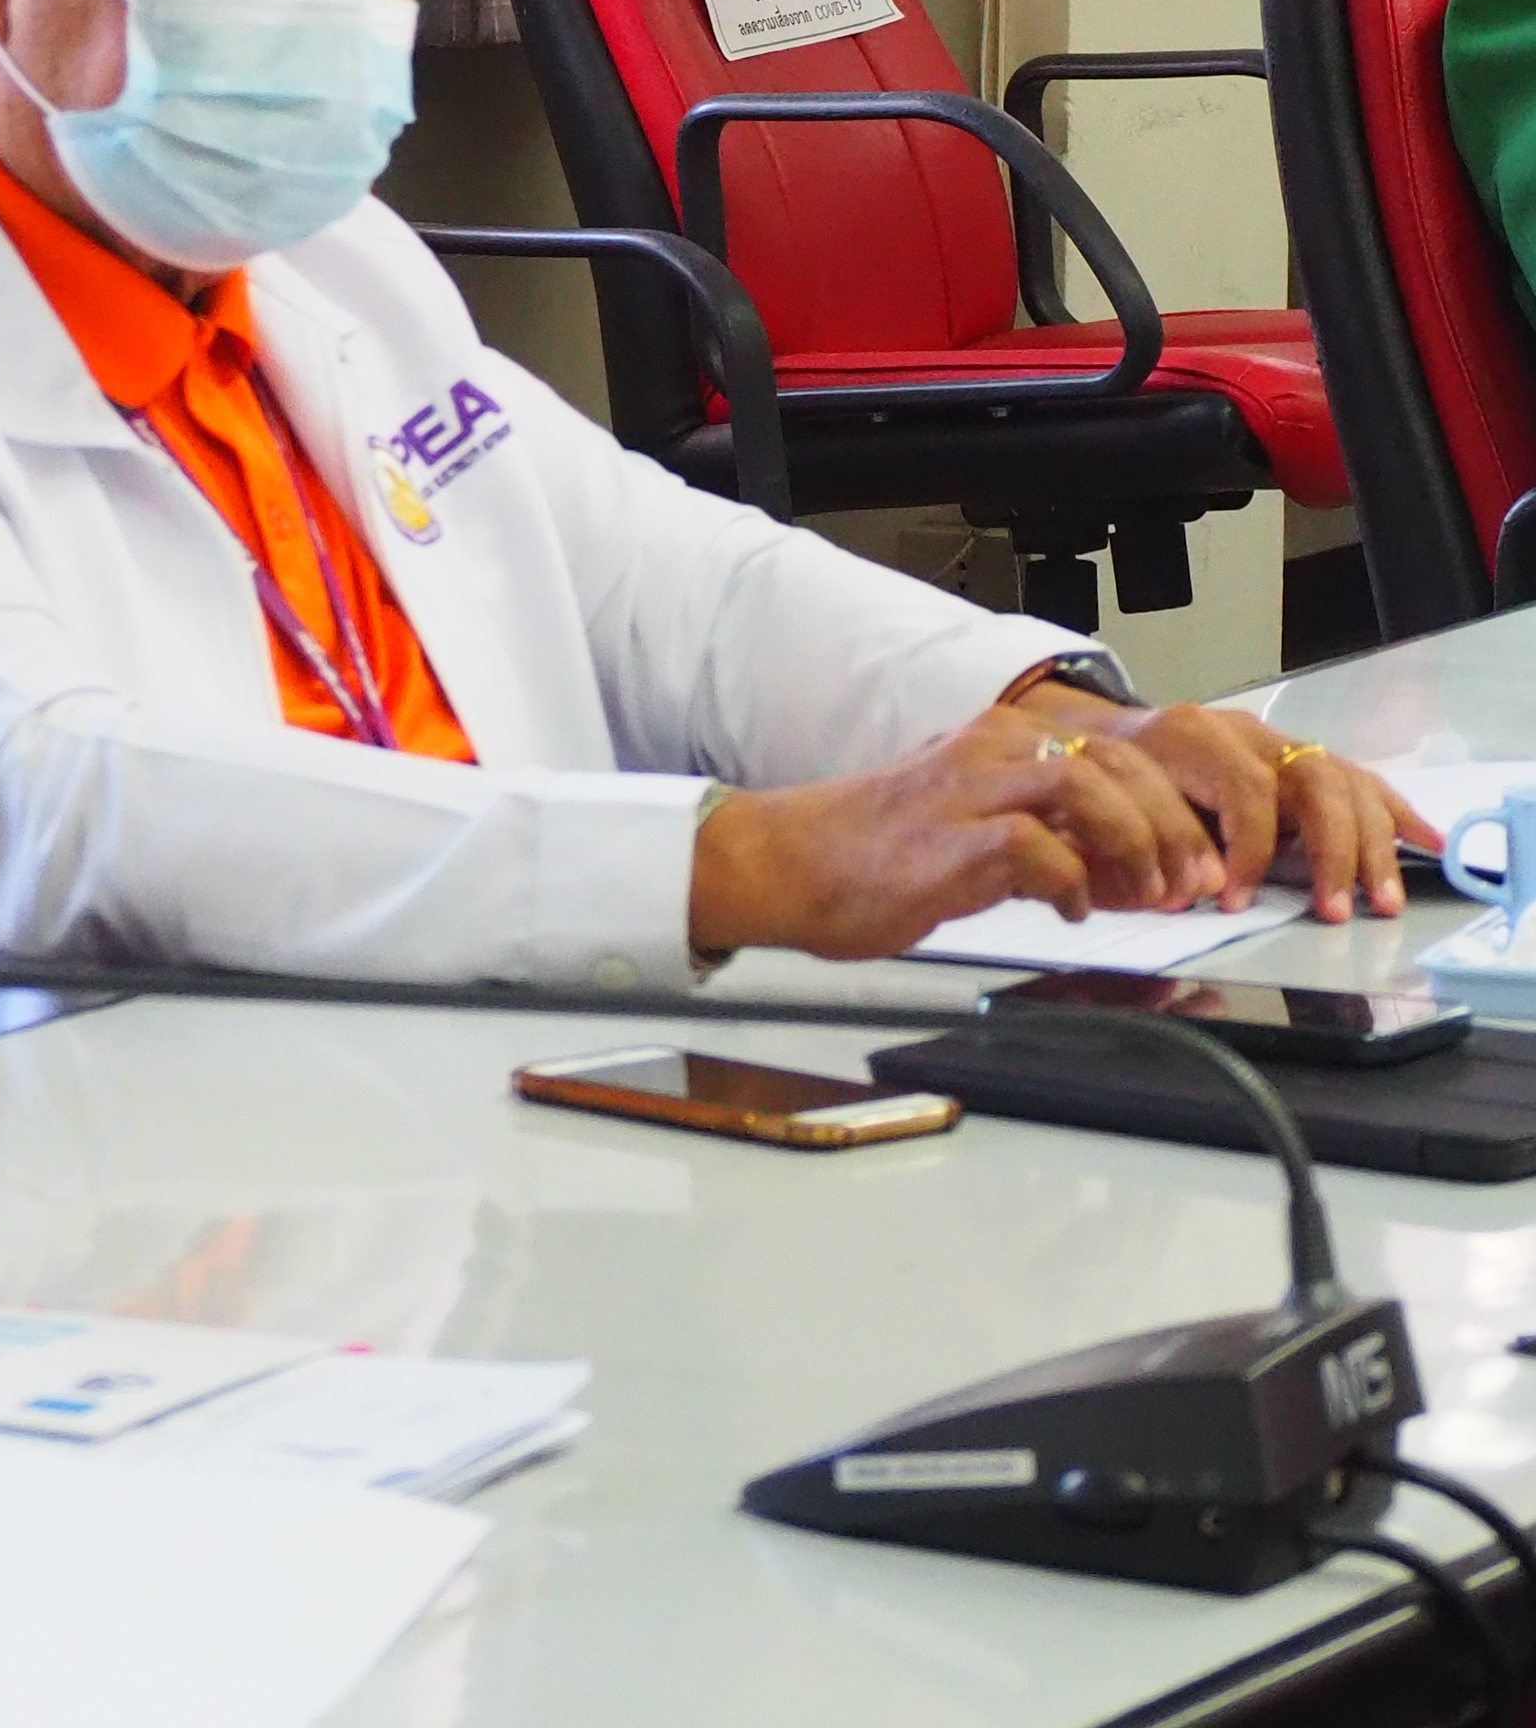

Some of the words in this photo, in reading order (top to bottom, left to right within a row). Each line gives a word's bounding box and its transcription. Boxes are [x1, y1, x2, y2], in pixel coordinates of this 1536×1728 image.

[738, 4, 813, 36] ลดความเสี่ยงจาก
